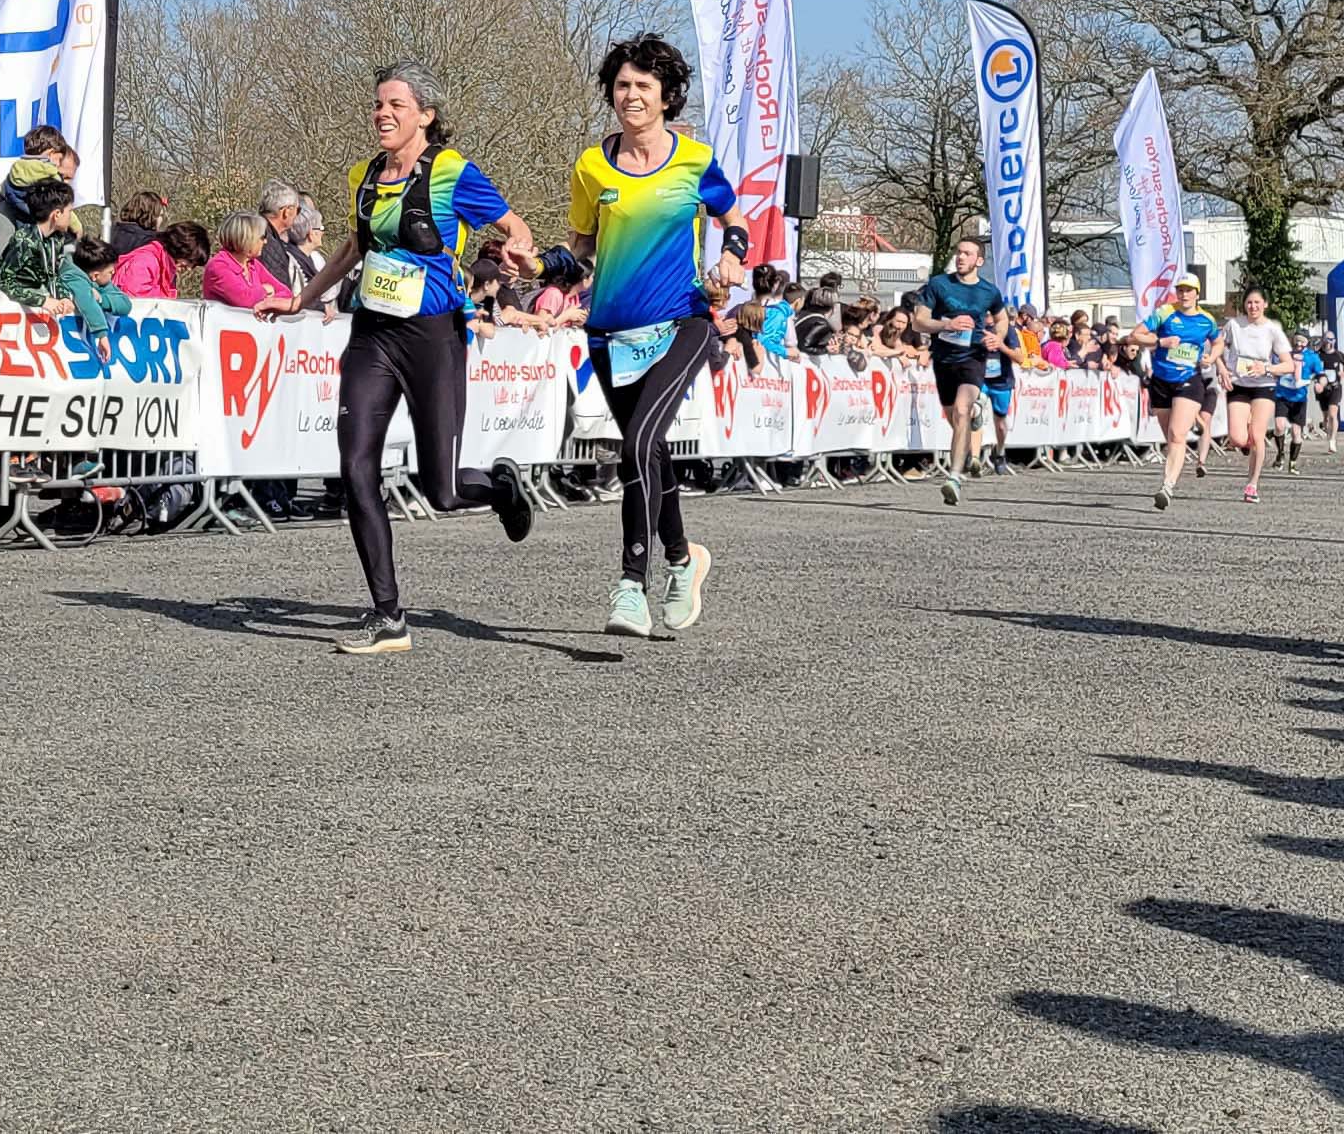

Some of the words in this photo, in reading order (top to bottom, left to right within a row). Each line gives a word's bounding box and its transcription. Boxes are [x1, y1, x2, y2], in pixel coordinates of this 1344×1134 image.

[373, 275, 398, 292] 920
[631, 344, 659, 361] 313
[285, 354, 296, 374] La
[60, 395, 124, 439] SUR
[135, 397, 179, 438] YON
